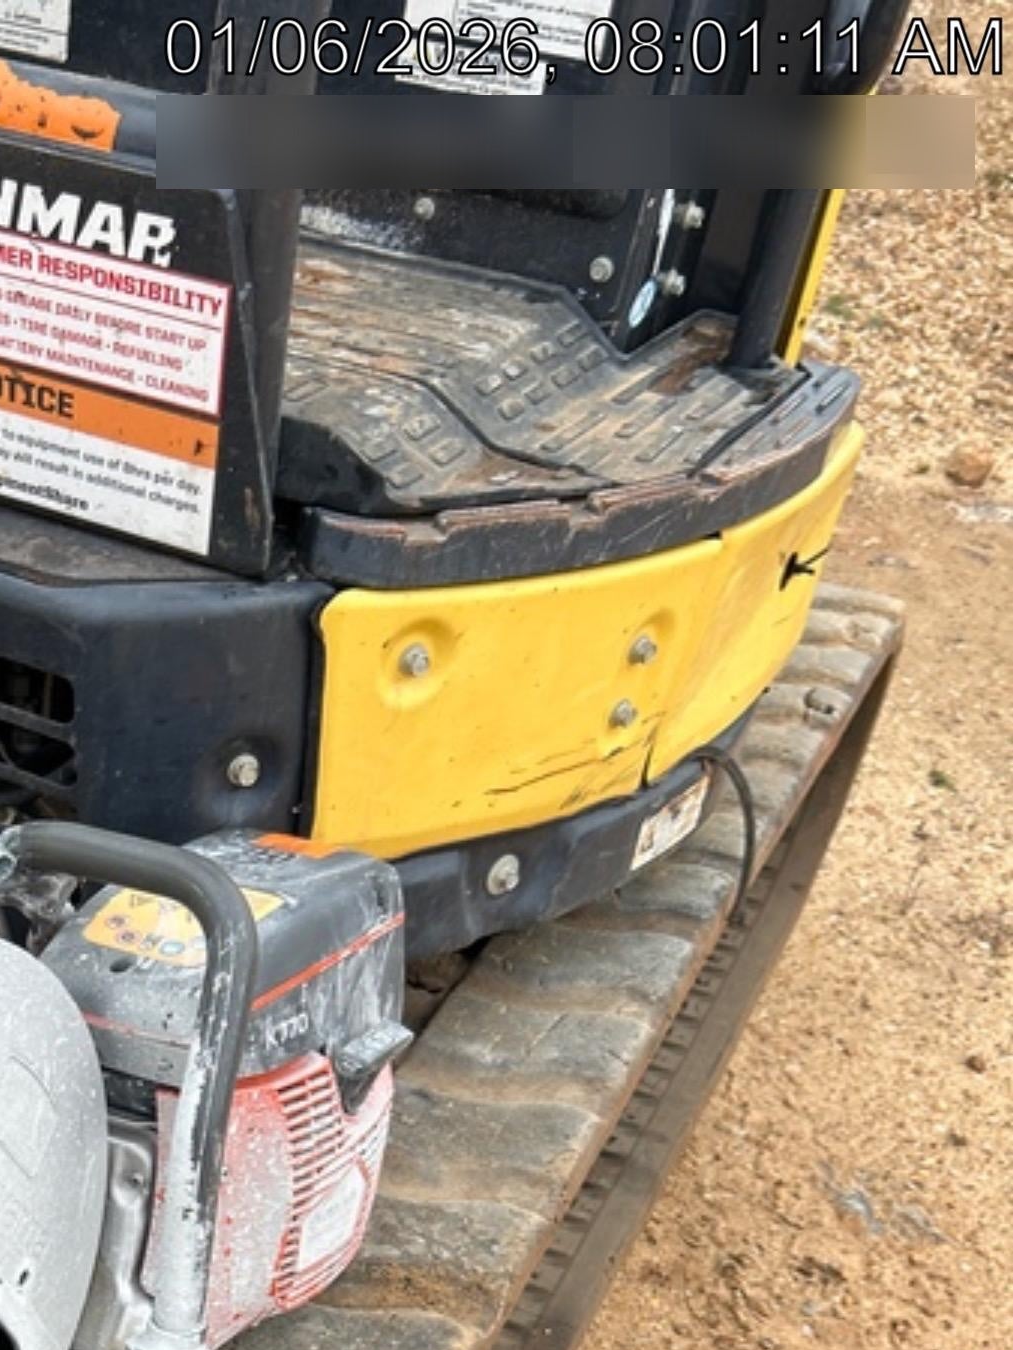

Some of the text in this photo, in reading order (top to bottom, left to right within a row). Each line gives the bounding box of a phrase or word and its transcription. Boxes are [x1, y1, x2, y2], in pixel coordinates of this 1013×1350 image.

[38, 254, 221, 317] RESPONSIBILITY
[6, 290, 50, 312] GREASE
[55, 303, 90, 323] DAILY
[94, 313, 140, 335] BEFORE
[145, 326, 184, 347] START
[188, 337, 206, 352] UP
[21, 319, 46, 335] TIRE
[51, 326, 102, 350] DAMAGE
[112, 342, 182, 371] REFUELING
[47, 349, 134, 383] MAINTENANCE
[145, 375, 208, 402] CLEANING
[2, 429, 13, 439] to
[18, 434, 79, 459] equipment
[83, 454, 104, 466] use
[107, 457, 119, 471] of
[152, 473, 173, 487] per
[176, 478, 201, 496] day.
[13, 450, 32, 465] will
[35, 457, 67, 475] result
[74, 468, 83, 479] in
[86, 471, 146, 498] additional
[149, 490, 197, 515] charges.
